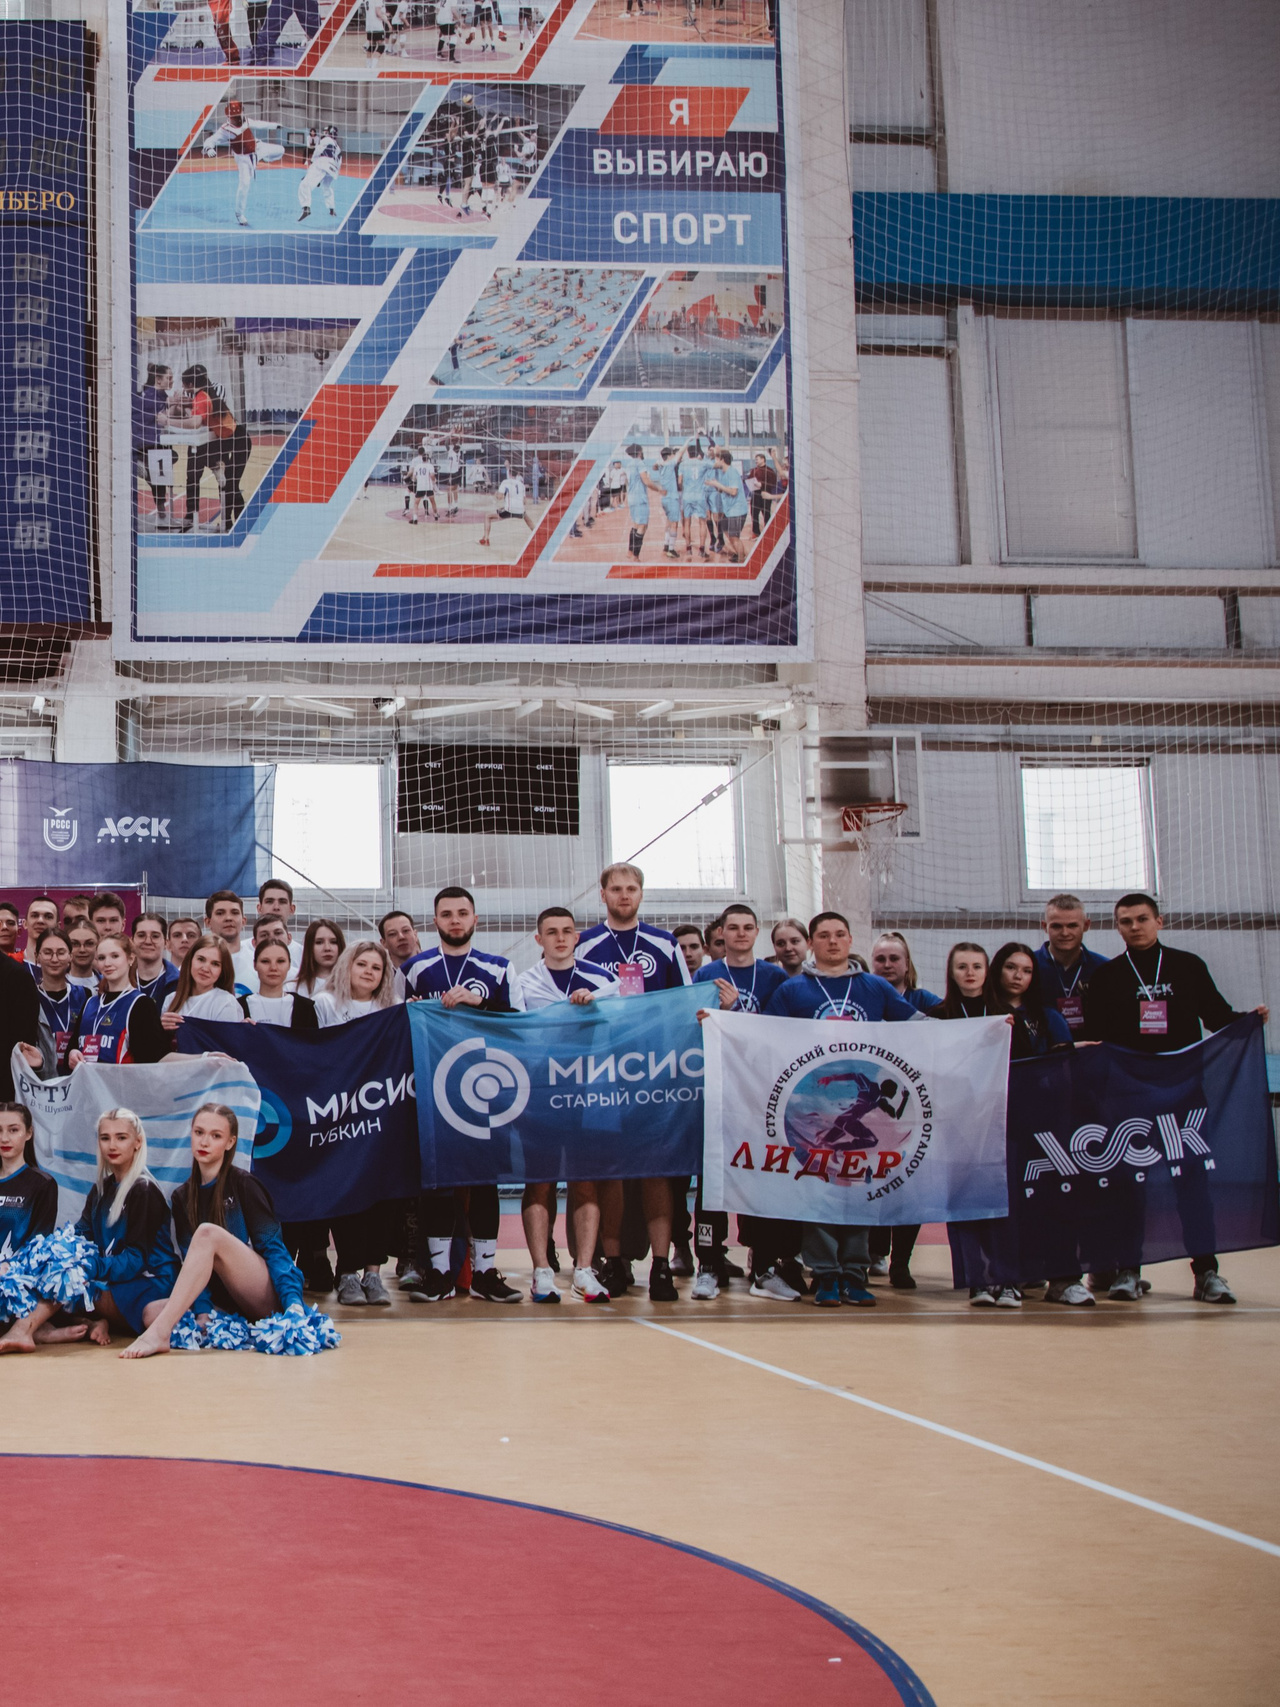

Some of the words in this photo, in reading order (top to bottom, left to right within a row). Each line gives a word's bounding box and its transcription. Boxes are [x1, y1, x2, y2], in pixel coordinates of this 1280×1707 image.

[669, 98, 690, 126] Я
[592, 148, 768, 178] ВЫБИРАЮ
[613, 211, 752, 246] СПОРТ
[97, 816, 171, 838] АССК
[828, 1042, 923, 1084] СПОРТИВНЫЙ
[549, 1086, 630, 1110] СТАРЫЙ
[765, 1043, 826, 1138] СТУДЕНЧЕСКИЙ
[915, 1083, 933, 1120] КЛУБ
[309, 1117, 382, 1148] ГУБКИН
[904, 1123, 933, 1178] ОГАПОУ
[1023, 1107, 1211, 1182] АССК
[730, 1141, 903, 1183] ЛИДЕР
[1025, 1158, 1216, 1199] РОССИИ
